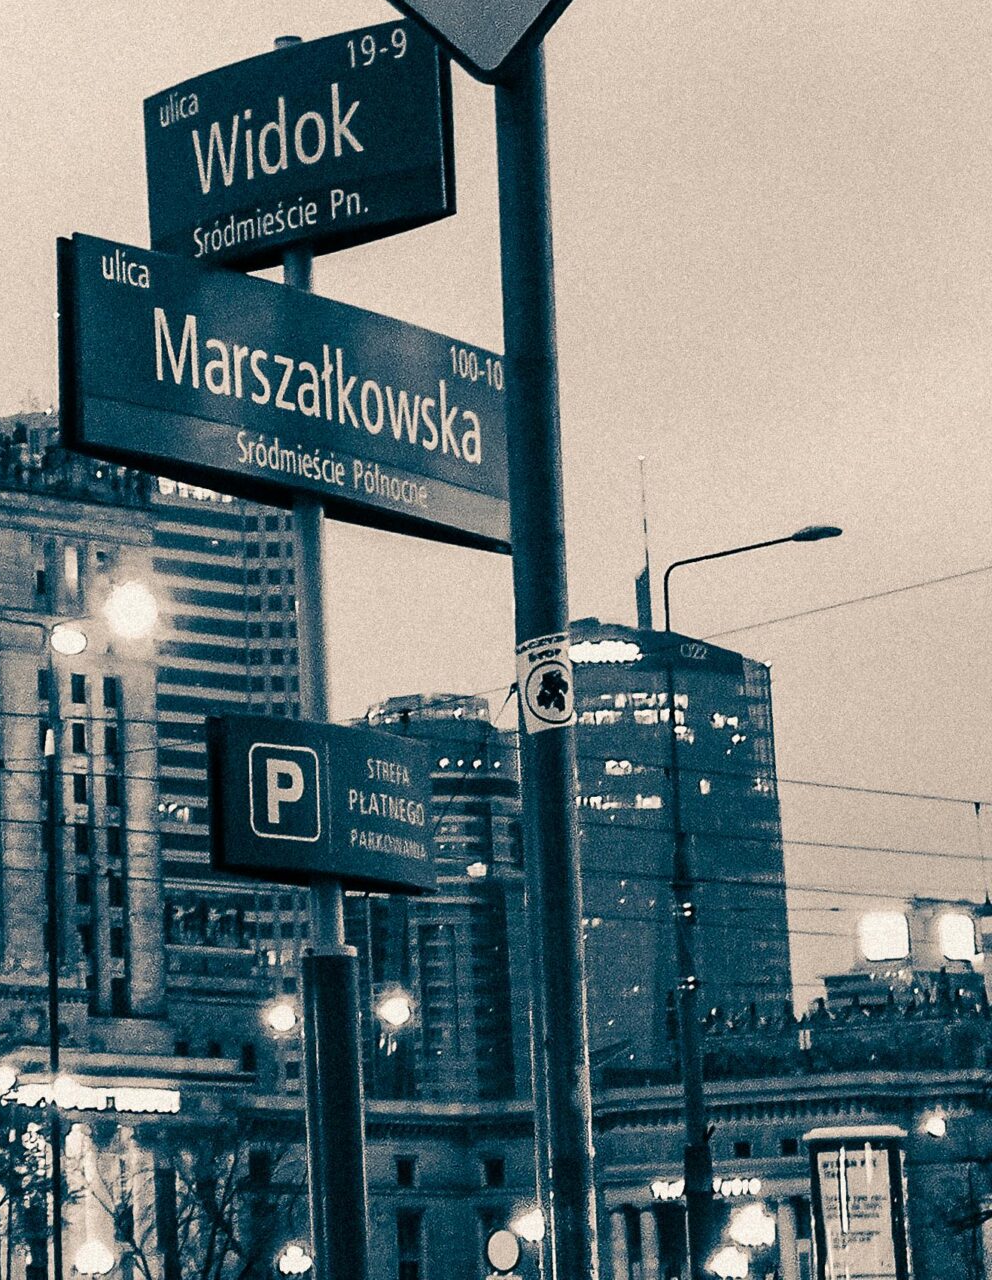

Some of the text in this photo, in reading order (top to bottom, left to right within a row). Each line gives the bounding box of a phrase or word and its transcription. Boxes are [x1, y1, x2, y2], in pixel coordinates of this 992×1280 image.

[347, 28, 407, 68] 19-9
[159, 92, 199, 127] ulica
[191, 82, 364, 194] Widok
[330, 188, 369, 220] Pn.
[102, 250, 150, 289] ulica
[154, 307, 483, 464] Marszałkowska
[266, 758, 305, 824] P
[366, 758, 411, 787] STREFA
[348, 789, 425, 827] PŁATNEGO
